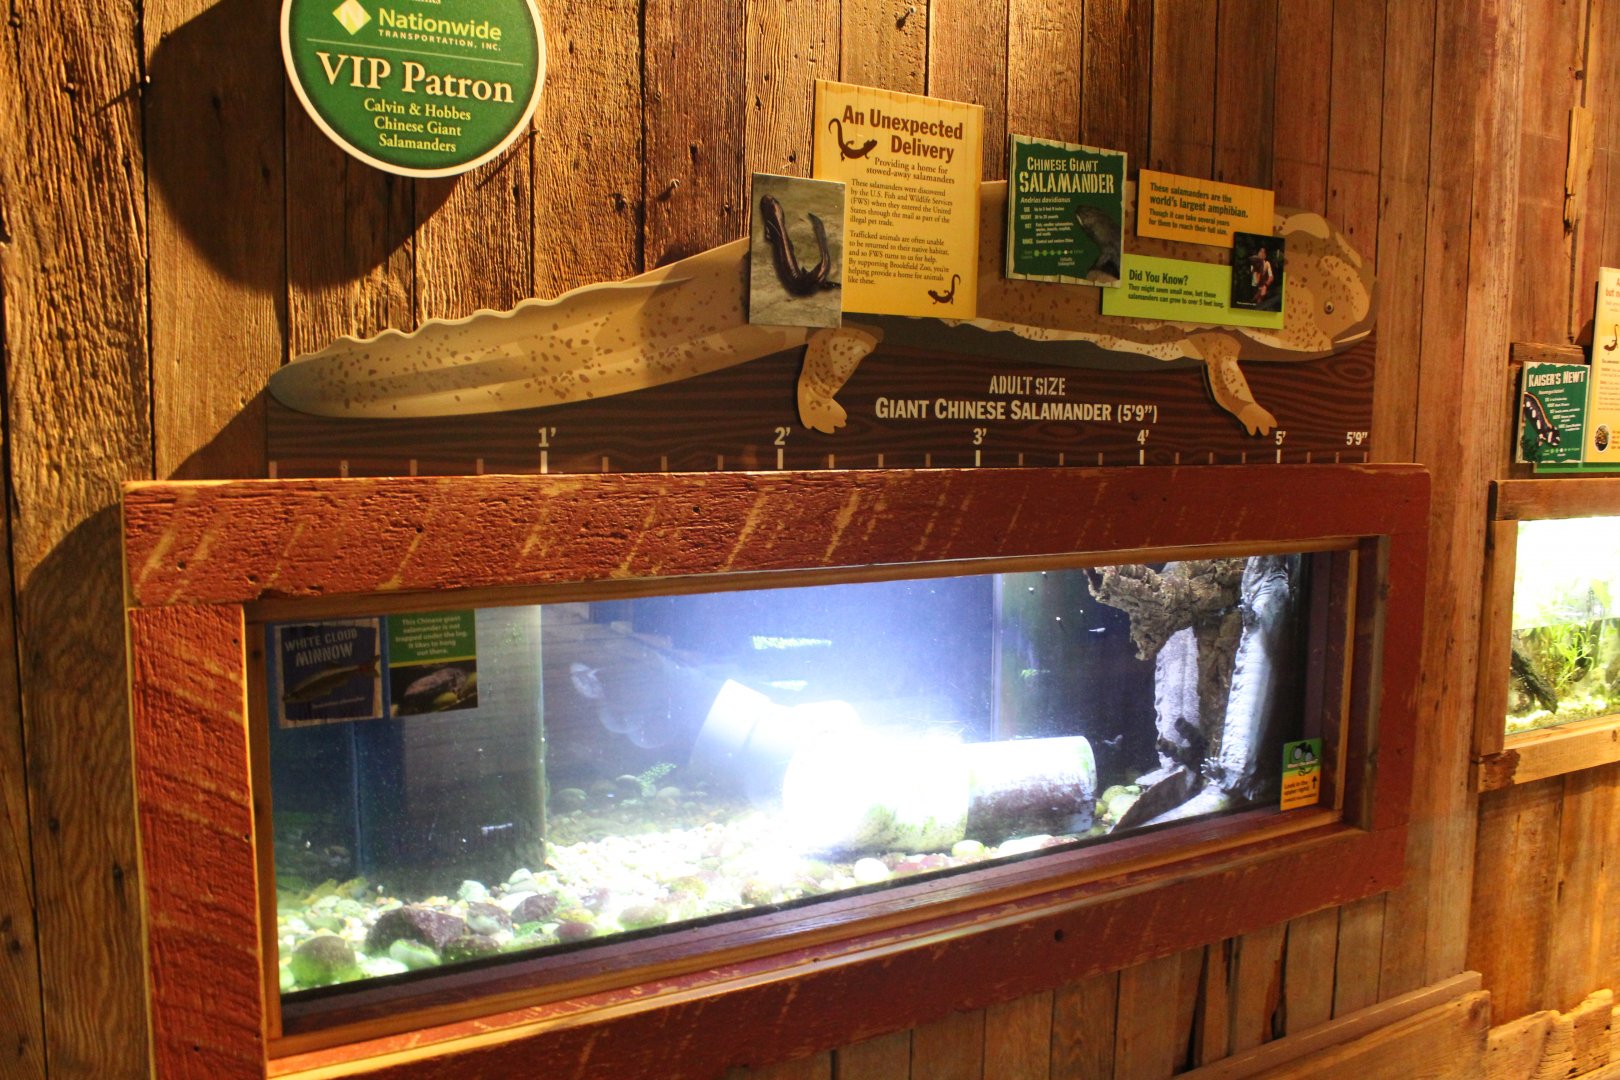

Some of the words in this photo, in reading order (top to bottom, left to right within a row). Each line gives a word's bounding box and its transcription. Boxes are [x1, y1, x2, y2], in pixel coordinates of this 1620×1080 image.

[379, 8, 502, 41] Nationwide
[379, 30, 477, 48] TRANSPORTATION,
[482, 42, 501, 50] INC.
[316, 52, 390, 90] VIP
[402, 62, 514, 103] Patron
[364, 98, 405, 114] Calvin
[409, 104, 421, 115] &
[425, 105, 471, 120] Hobbes
[374, 117, 424, 133] Chinese
[427, 121, 462, 136] Giant
[842, 105, 864, 126] An
[870, 109, 963, 140] Unexpected
[379, 134, 456, 152] Salamanders
[891, 135, 954, 164] Delivery
[866, 166, 911, 180] stowed-away
[913, 172, 955, 184] salamanders
[874, 157, 909, 170] Providing
[917, 163, 936, 173] home
[938, 165, 948, 174] for
[852, 179, 868, 187] These
[870, 181, 902, 191] salamanders
[918, 187, 945, 196] discovered
[1020, 172, 1114, 193] SALAMANDER
[909, 194, 931, 203] Wildlife
[1150, 182, 1168, 192] These
[1171, 186, 1209, 199] salamanders
[1222, 194, 1232, 203] the
[888, 201, 900, 209] they
[1150, 196, 1178, 207] world's
[1180, 198, 1206, 212] largest
[1208, 203, 1248, 218] amphibian.
[850, 215, 866, 225] illegal
[868, 218, 877, 226] pet
[850, 230, 878, 239] Trafficked
[869, 250, 883, 258] FWS
[848, 267, 869, 276] helping
[871, 270, 892, 278] provide
[1129, 269, 1142, 281] Did
[1145, 272, 1160, 282] You
[1162, 273, 1188, 286] Know?
[1128, 294, 1158, 302] salamanders
[989, 375, 1033, 395] ADULT
[1035, 377, 1066, 396] SIZE
[1529, 373, 1561, 387] KAISER'S
[1563, 371, 1586, 384] NEWT
[875, 397, 929, 420] GIANT
[934, 398, 1006, 420] CHINESE
[1010, 400, 1112, 421] SALAMANDER
[538, 427, 556, 447] 1'
[774, 427, 791, 445] 2'
[973, 428, 987, 445] 3'
[1137, 429, 1150, 445] 4'
[1275, 431, 1286, 446] 5'
[284, 634, 321, 651] WHITE
[325, 628, 358, 645] CLOUD
[295, 643, 353, 667] MINNOW
